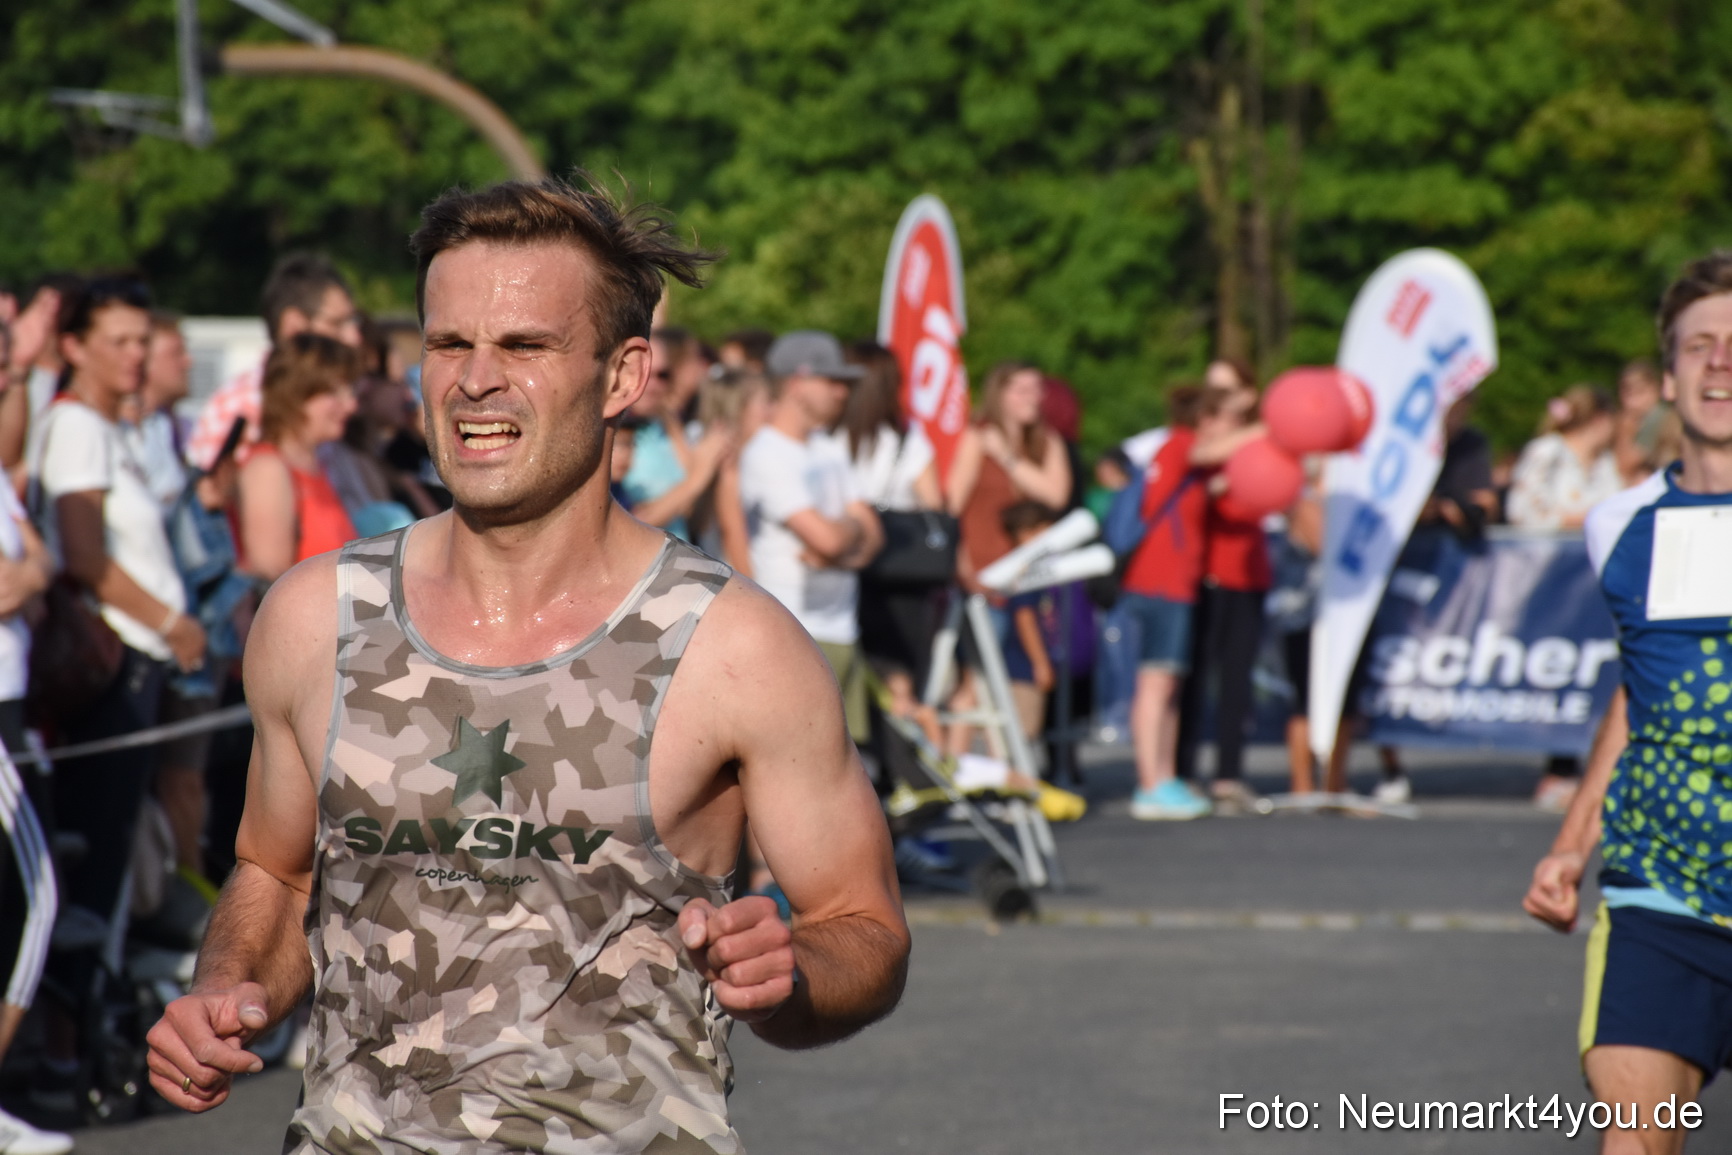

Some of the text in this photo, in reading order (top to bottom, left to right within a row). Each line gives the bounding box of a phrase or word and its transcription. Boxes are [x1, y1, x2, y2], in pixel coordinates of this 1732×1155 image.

[1370, 620, 1619, 689] scher
[344, 816, 615, 865] SAYSKY
[415, 866, 540, 894] copenhagen
